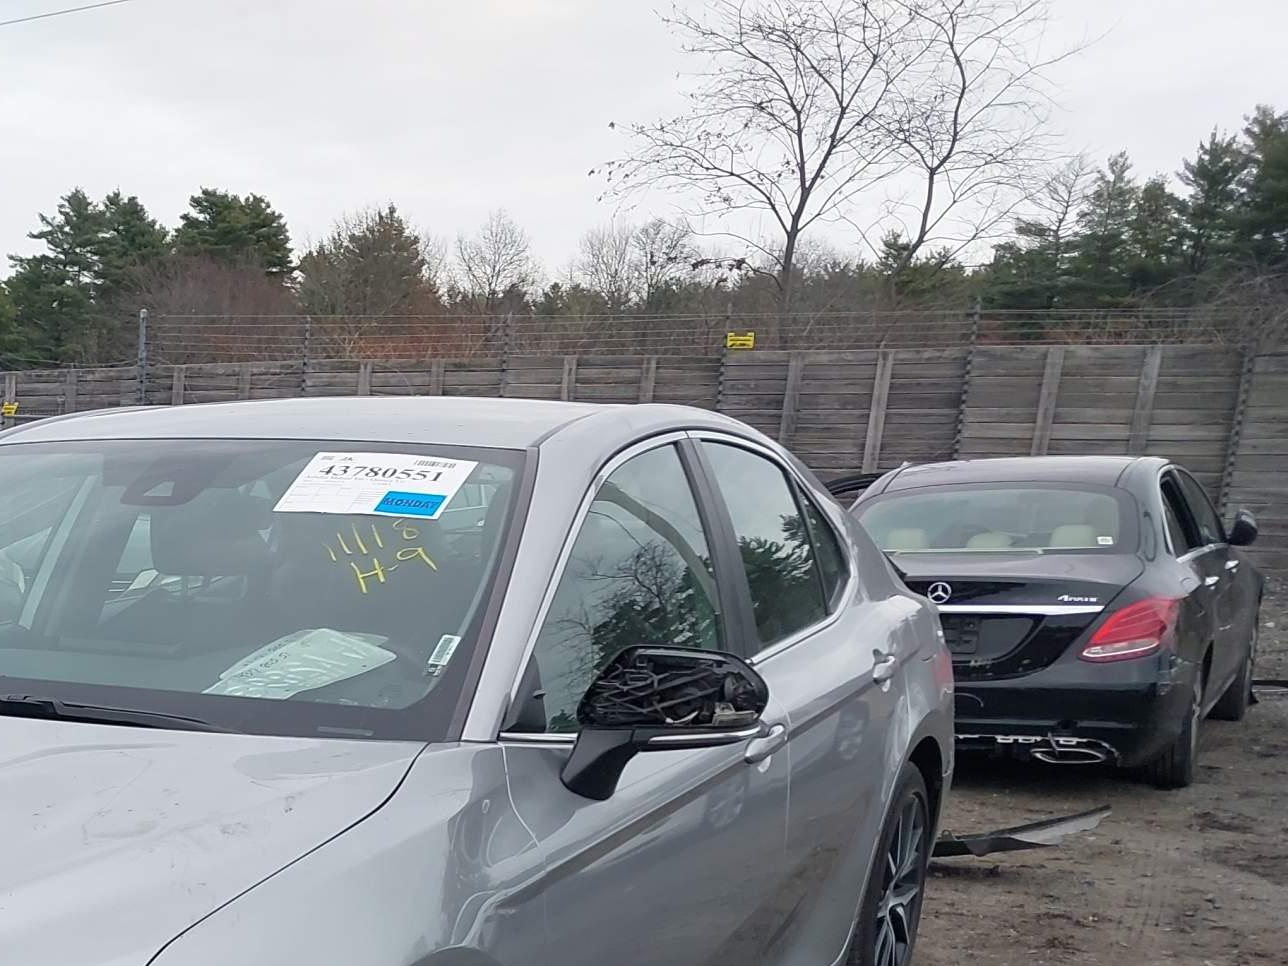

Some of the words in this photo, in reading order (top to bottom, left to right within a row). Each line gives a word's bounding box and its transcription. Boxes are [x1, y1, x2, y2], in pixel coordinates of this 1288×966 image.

[319, 464, 444, 482] 43780551
[383, 496, 440, 510] MONDAY
[350, 546, 438, 593] H-9
